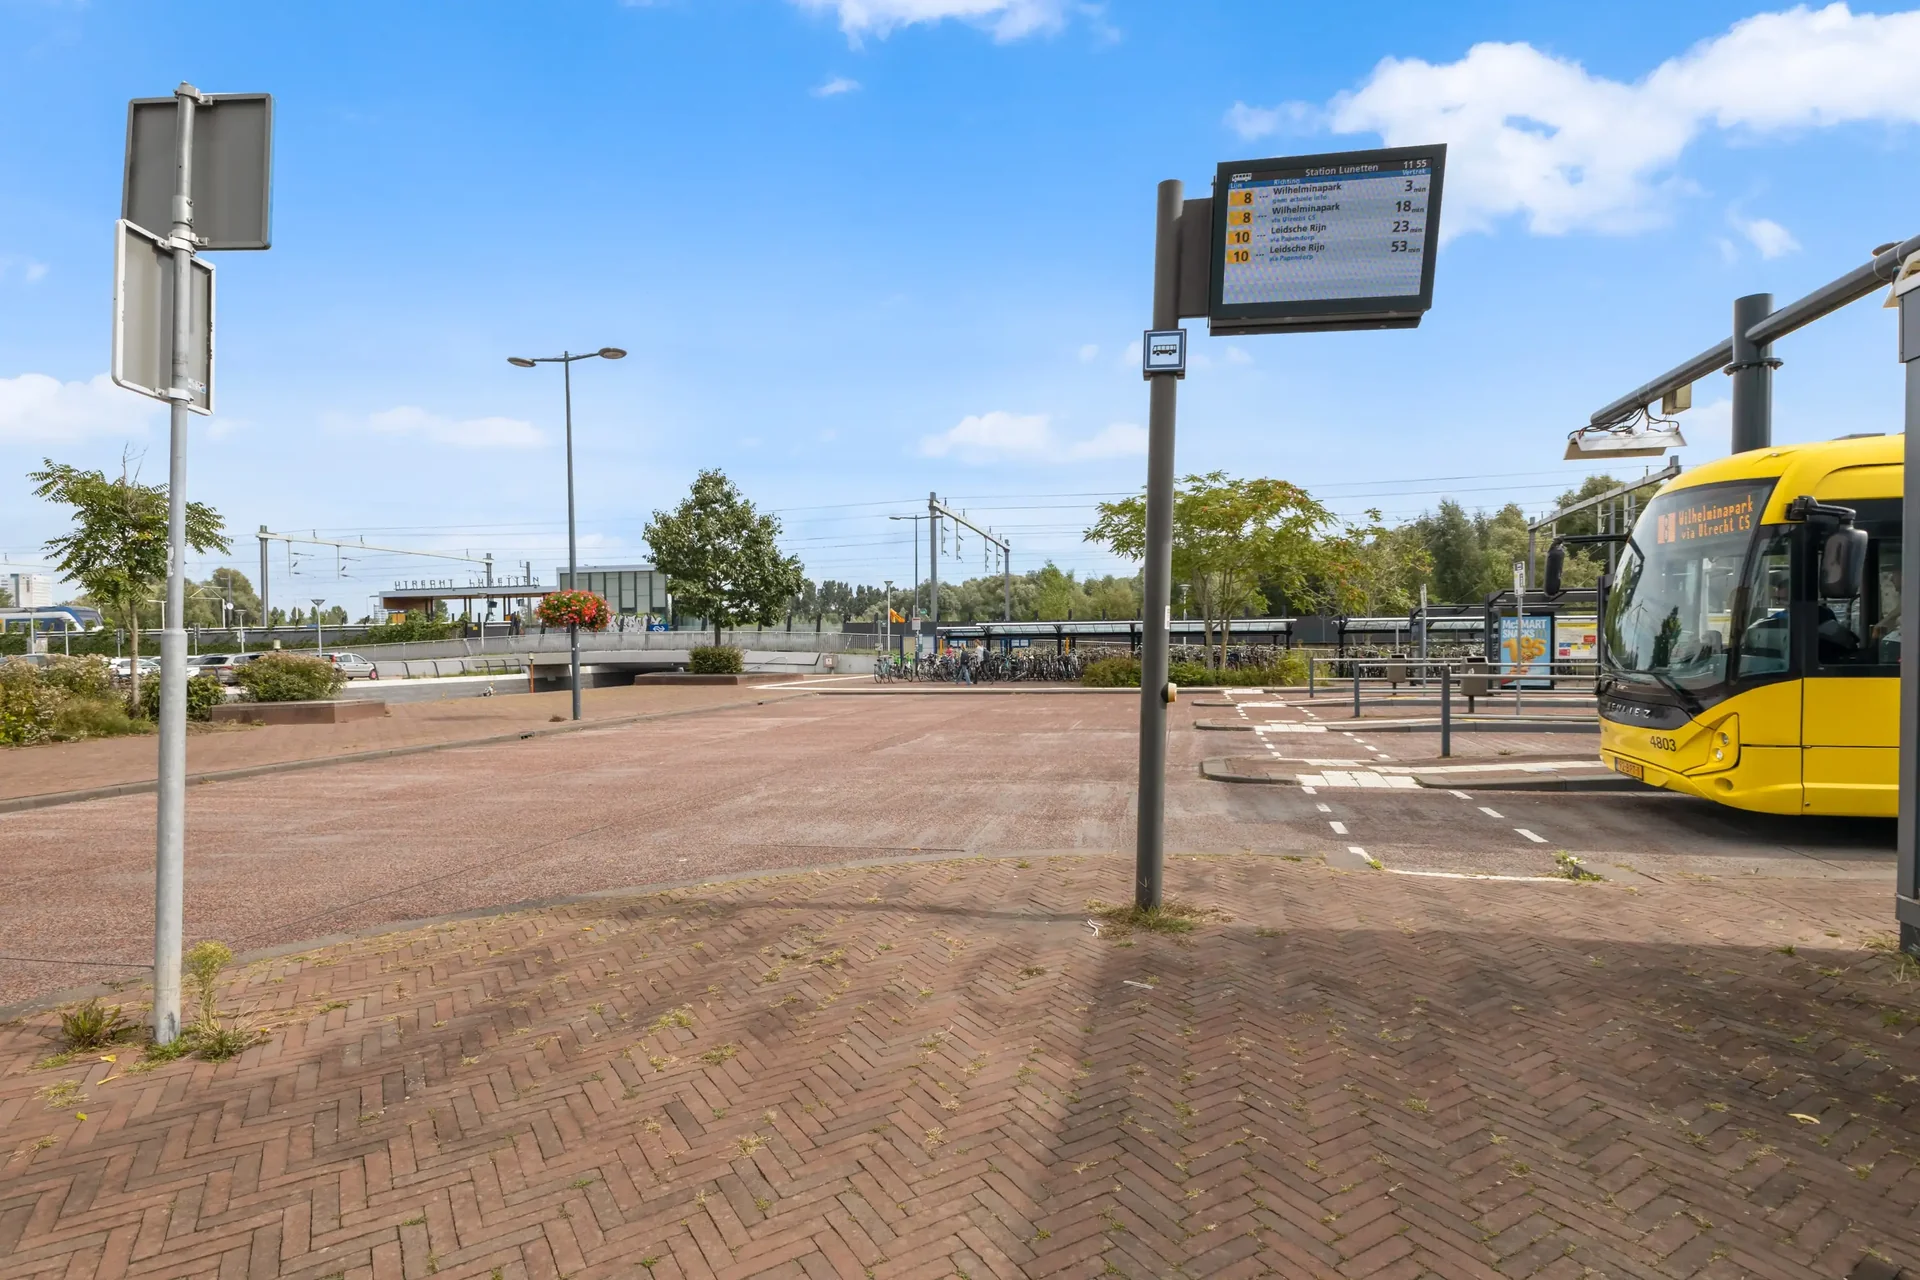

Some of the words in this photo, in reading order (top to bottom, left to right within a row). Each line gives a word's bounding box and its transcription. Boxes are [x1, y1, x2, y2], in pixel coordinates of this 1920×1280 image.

[1305, 167, 1336, 177] Station
[1339, 164, 1379, 174] Lunetten
[1243, 192, 1252, 204] 8
[1273, 183, 1342, 195] Wilhelminapark
[1404, 180, 1413, 192] 3
[1243, 211, 1251, 223] 8
[1272, 203, 1340, 215] Wilhelminapark
[1395, 200, 1412, 213] 18
[1234, 231, 1250, 243] 10
[1271, 225, 1308, 234] Leidsche
[1310, 224, 1327, 233] Rijn
[1392, 220, 1410, 233] 23
[1233, 250, 1249, 262] 10
[1270, 245, 1306, 254] Leidsche
[1308, 243, 1325, 252] Rijn
[1391, 240, 1408, 253] 53
[1678, 494, 1754, 526] Wilhelminapark
[1681, 528, 1695, 540] via
[1698, 518, 1734, 538] Utrecht
[1738, 514, 1751, 531] CS
[1650, 735, 1677, 752] 4803
